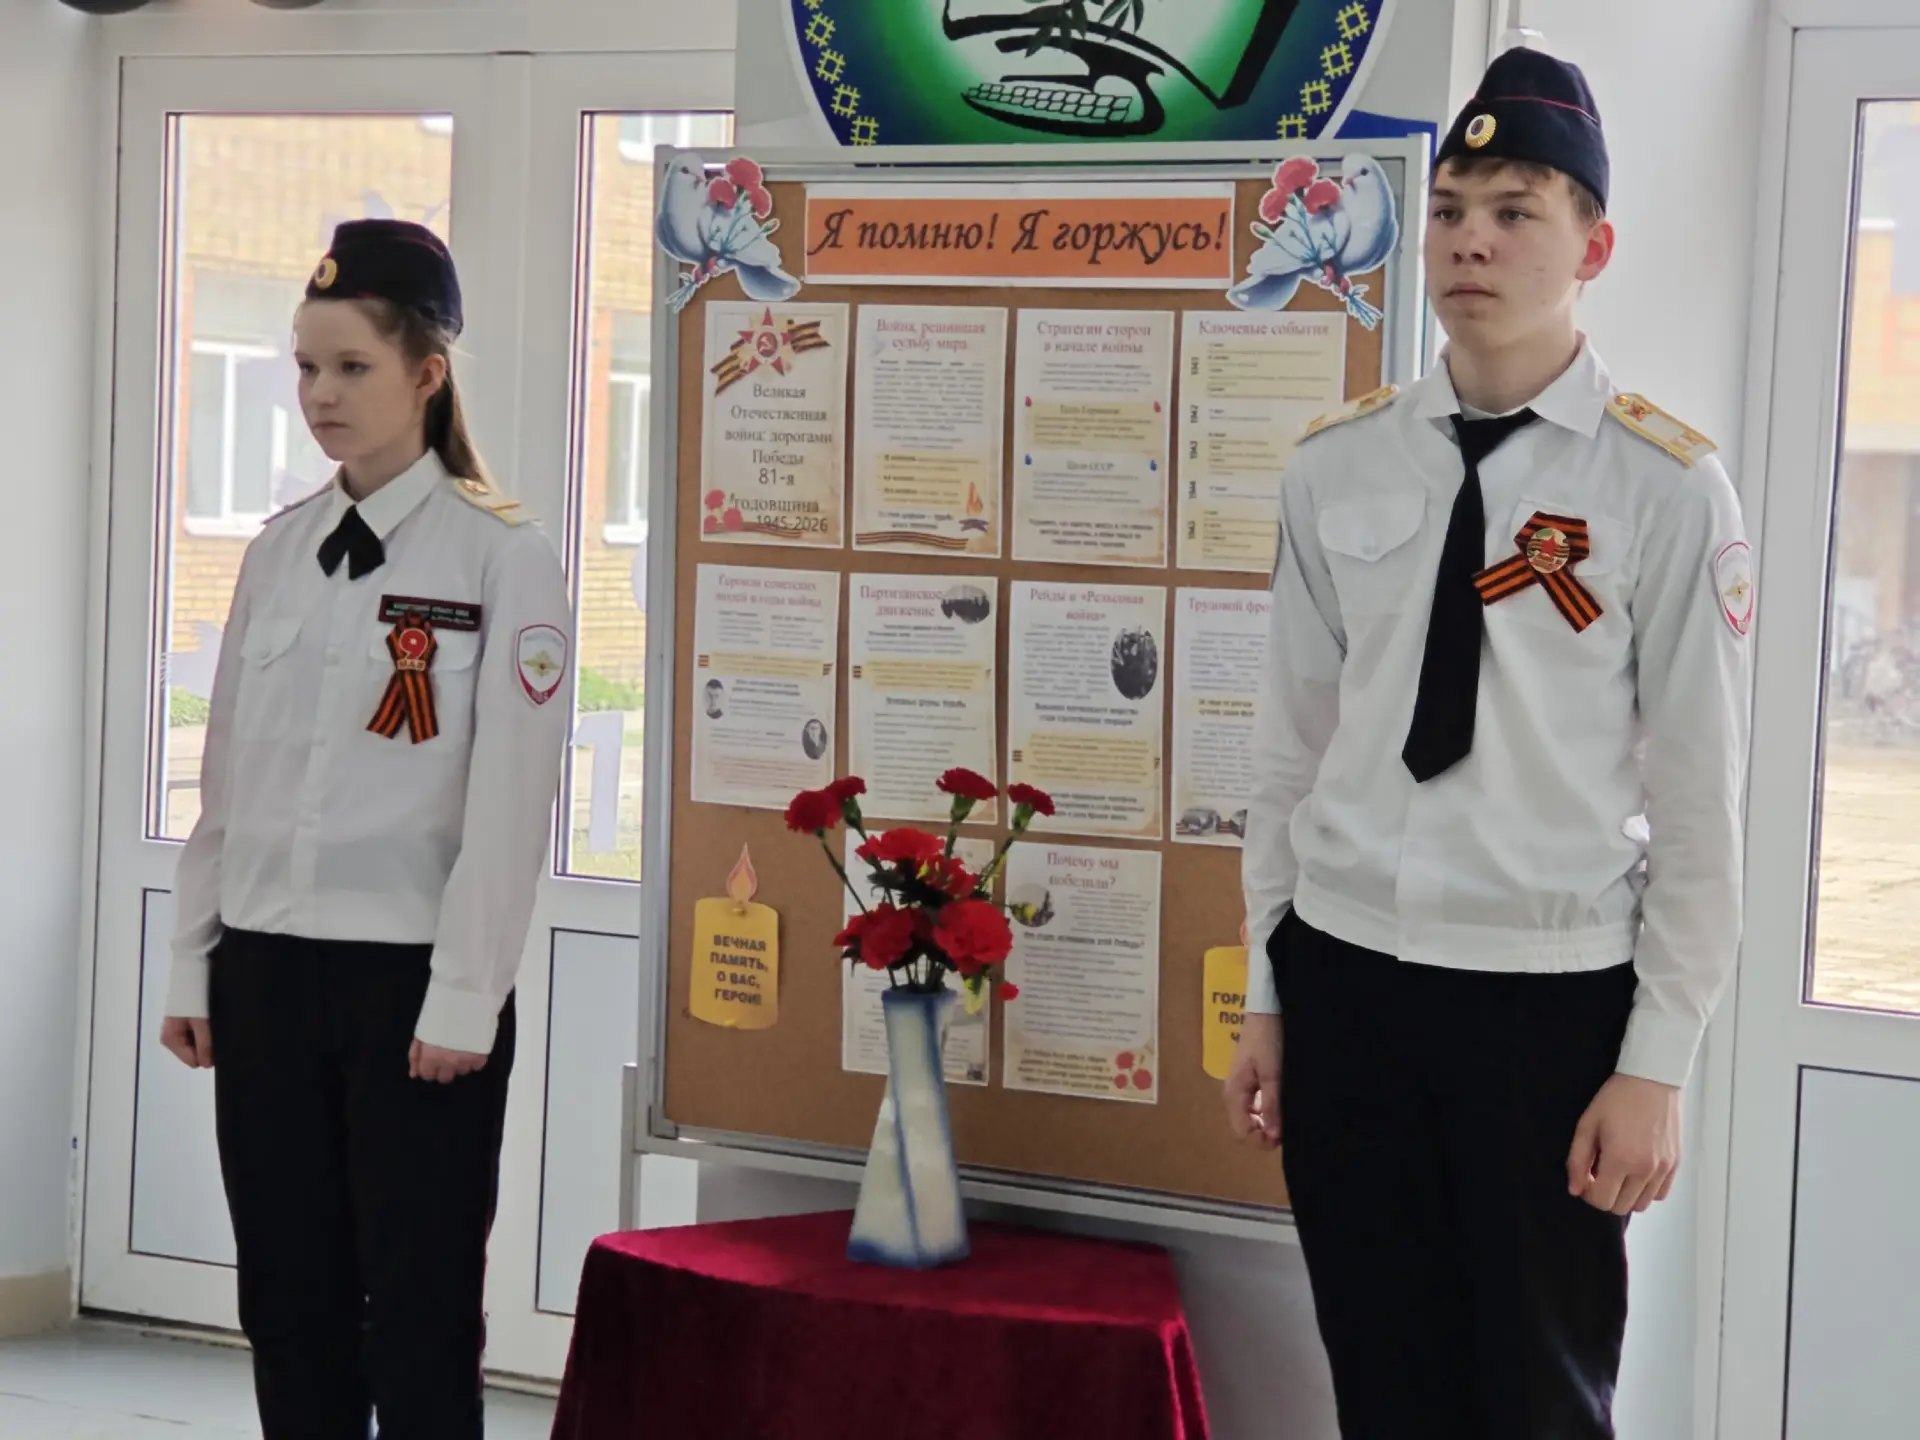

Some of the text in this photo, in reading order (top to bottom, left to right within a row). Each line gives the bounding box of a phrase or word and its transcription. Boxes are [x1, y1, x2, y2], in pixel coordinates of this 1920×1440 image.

[807, 209, 1227, 265] Я помню! Я горжусь!
[1037, 320, 1151, 339] Стратегии сторон
[1199, 320, 1329, 336] Ключевые события
[1055, 344, 1098, 353] начале
[1102, 341, 1143, 353] войны
[753, 383, 806, 400] Великая
[730, 405, 828, 422] Отечественная
[769, 431, 833, 445] дорогами
[752, 450, 804, 465] Победы
[758, 467, 795, 487] 81-я
[756, 514, 829, 533] 1945-2026
[860, 585, 944, 602] Партизанское
[876, 605, 936, 617] движение
[1189, 597, 1270, 616] Трудовой фро
[1047, 852, 1120, 871] Почему мы
[1048, 875, 1116, 889] победили?
[713, 934, 767, 952] ВЕЧНАЯ
[710, 951, 769, 973] ПАМЯТЬ,
[716, 970, 761, 989] О ВАС,
